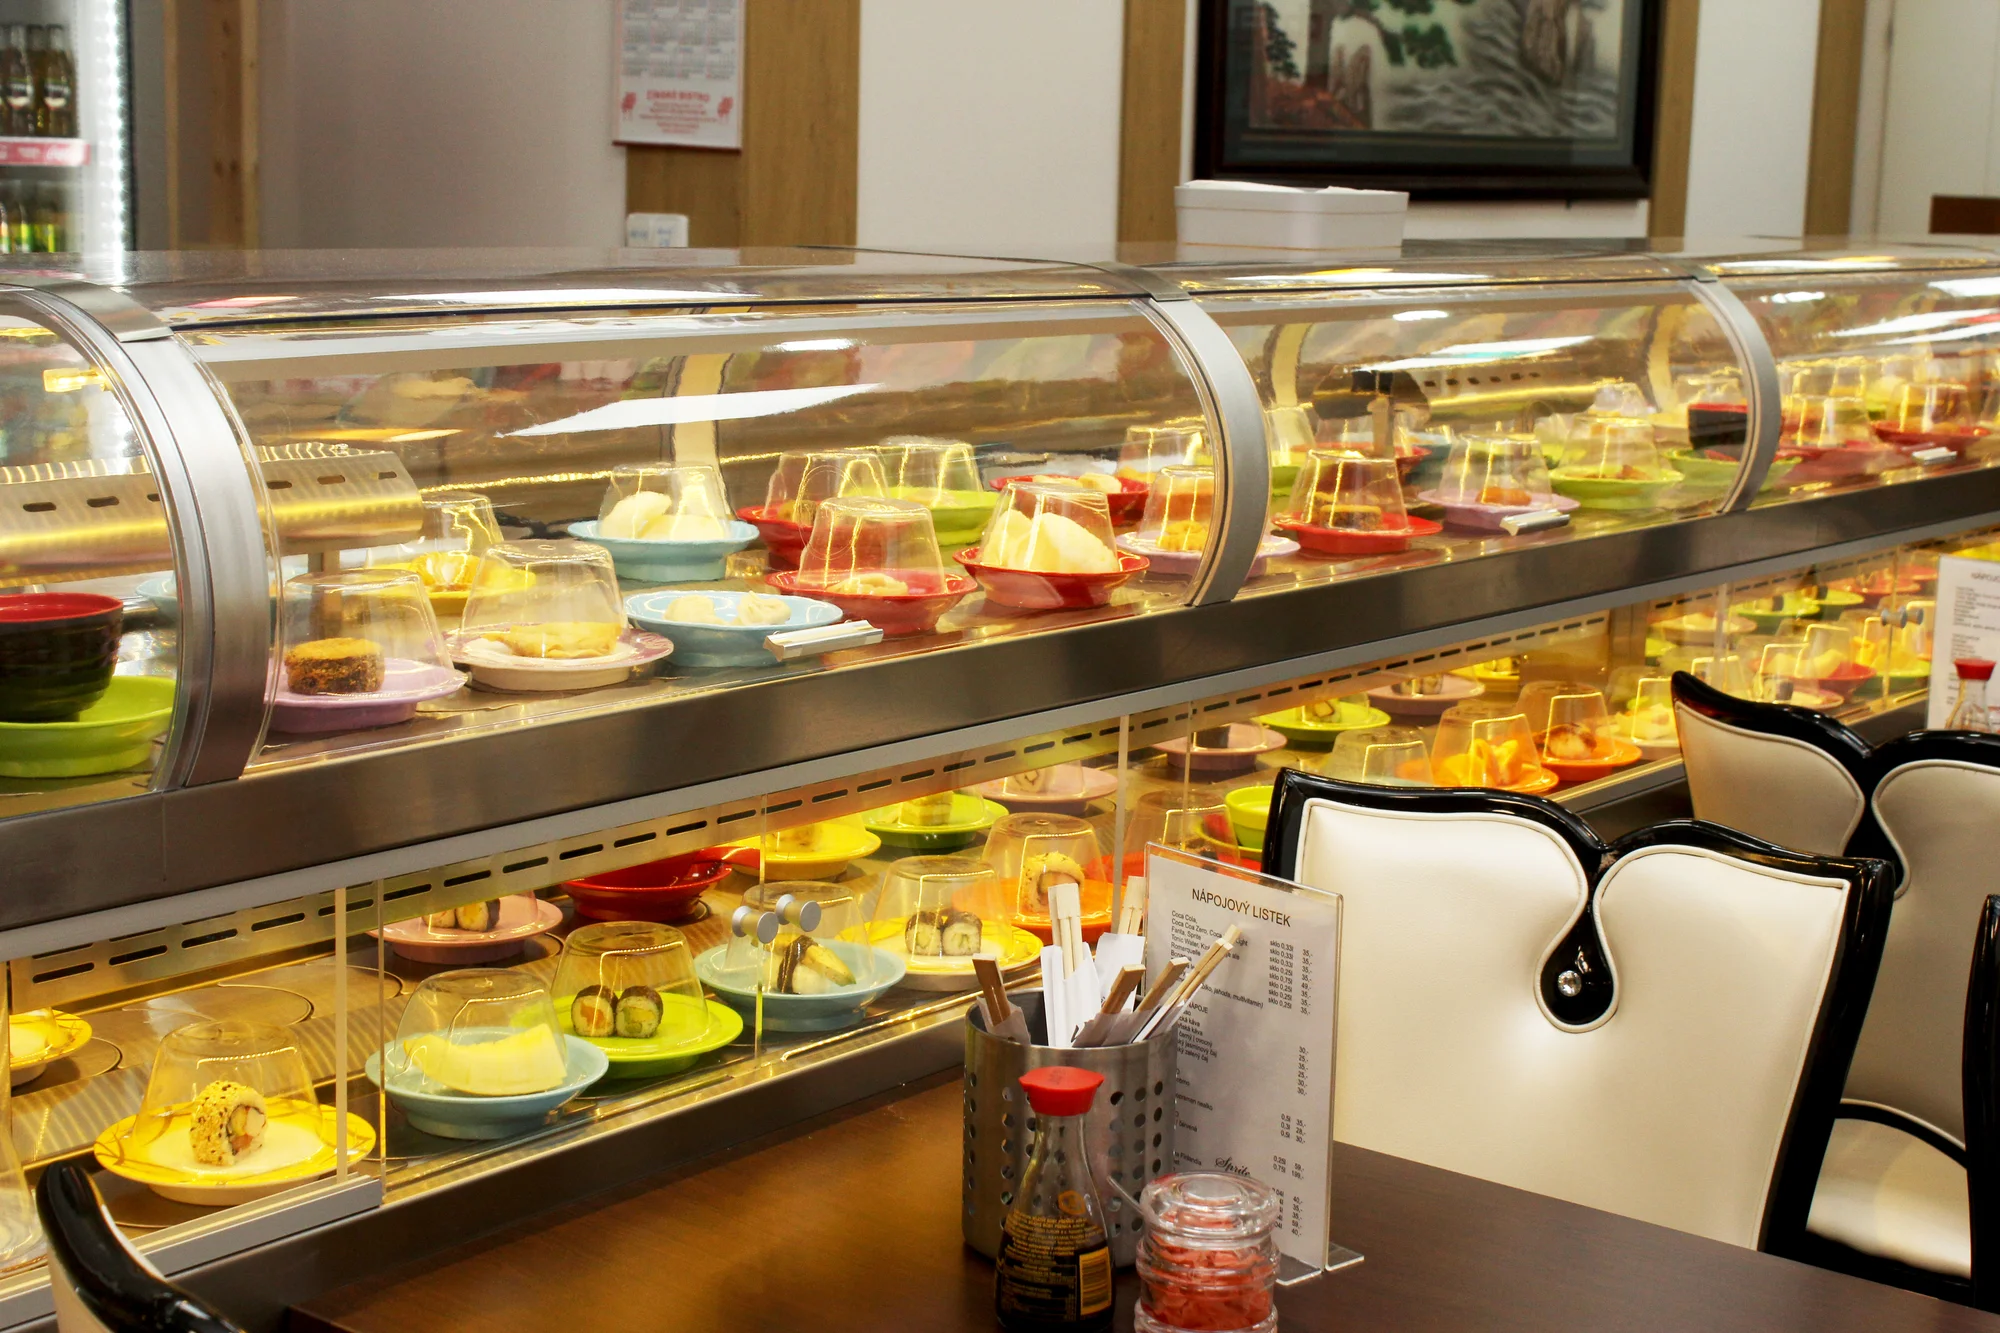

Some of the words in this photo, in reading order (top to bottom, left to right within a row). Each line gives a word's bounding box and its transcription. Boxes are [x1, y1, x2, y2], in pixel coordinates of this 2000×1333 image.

[1172, 910, 1184, 919] Coca
[1185, 914, 1197, 923] Cola,
[1192, 888, 1250, 914] NÁPOJOVÝ
[1253, 906, 1291, 927] LISTEK
[1172, 918, 1183, 927] Coca
[1196, 926, 1208, 935] Zero,
[1210, 930, 1222, 938] Coca
